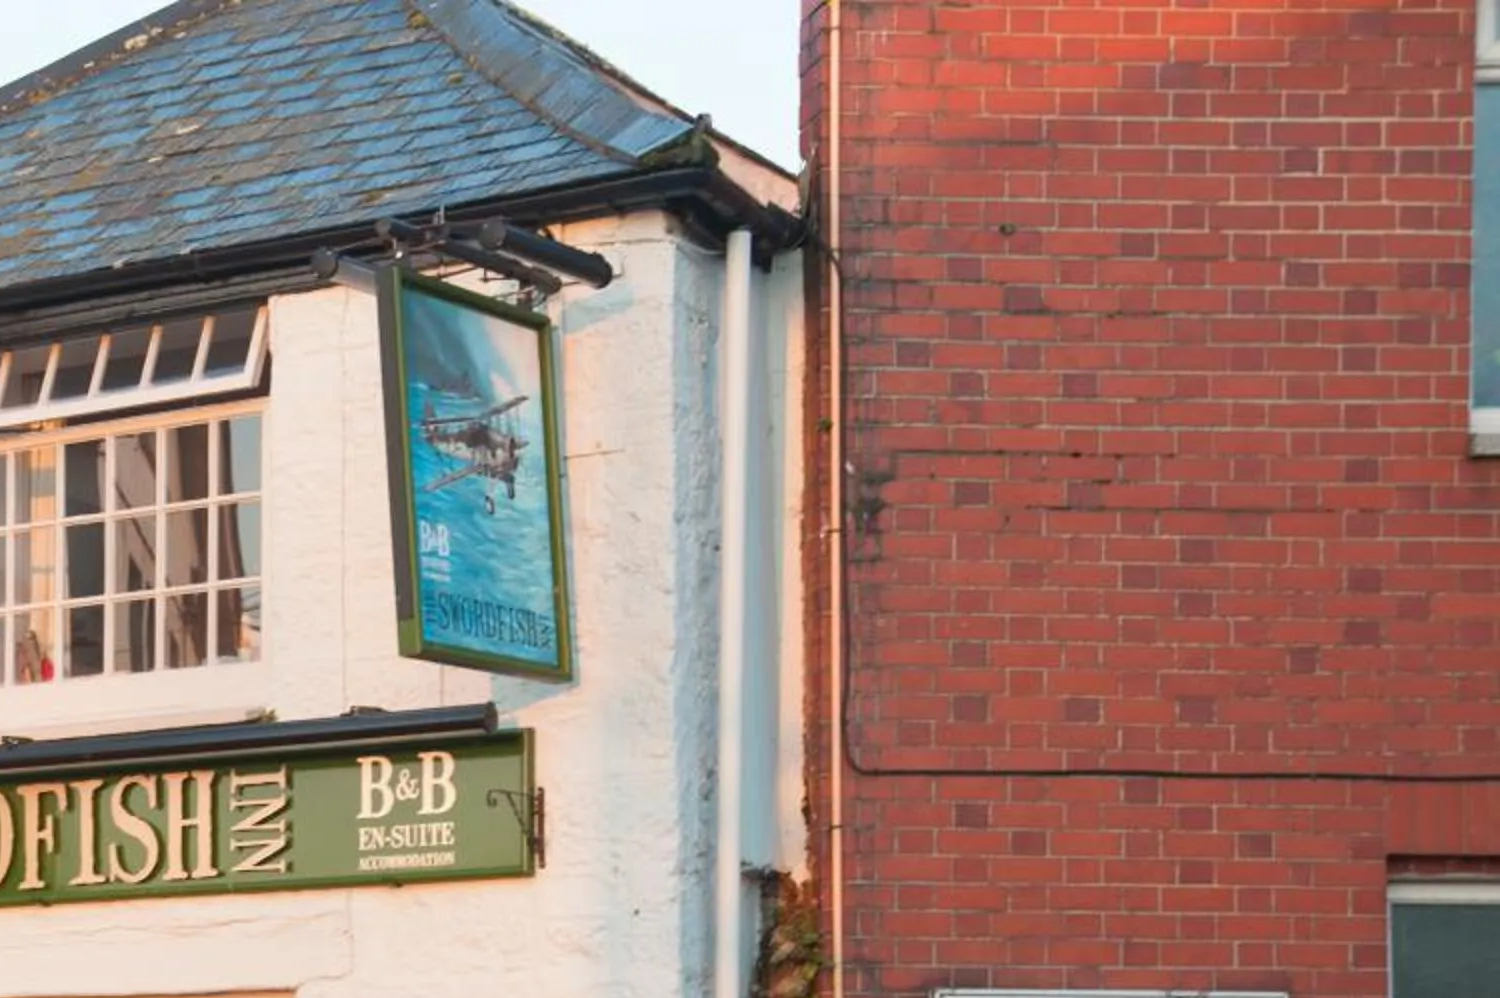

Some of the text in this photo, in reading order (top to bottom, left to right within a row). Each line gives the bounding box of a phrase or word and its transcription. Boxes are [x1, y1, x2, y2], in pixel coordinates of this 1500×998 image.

[229, 763, 289, 875] INN
[356, 751, 457, 820] B&B
[358, 821, 456, 851] EN-SUITE
